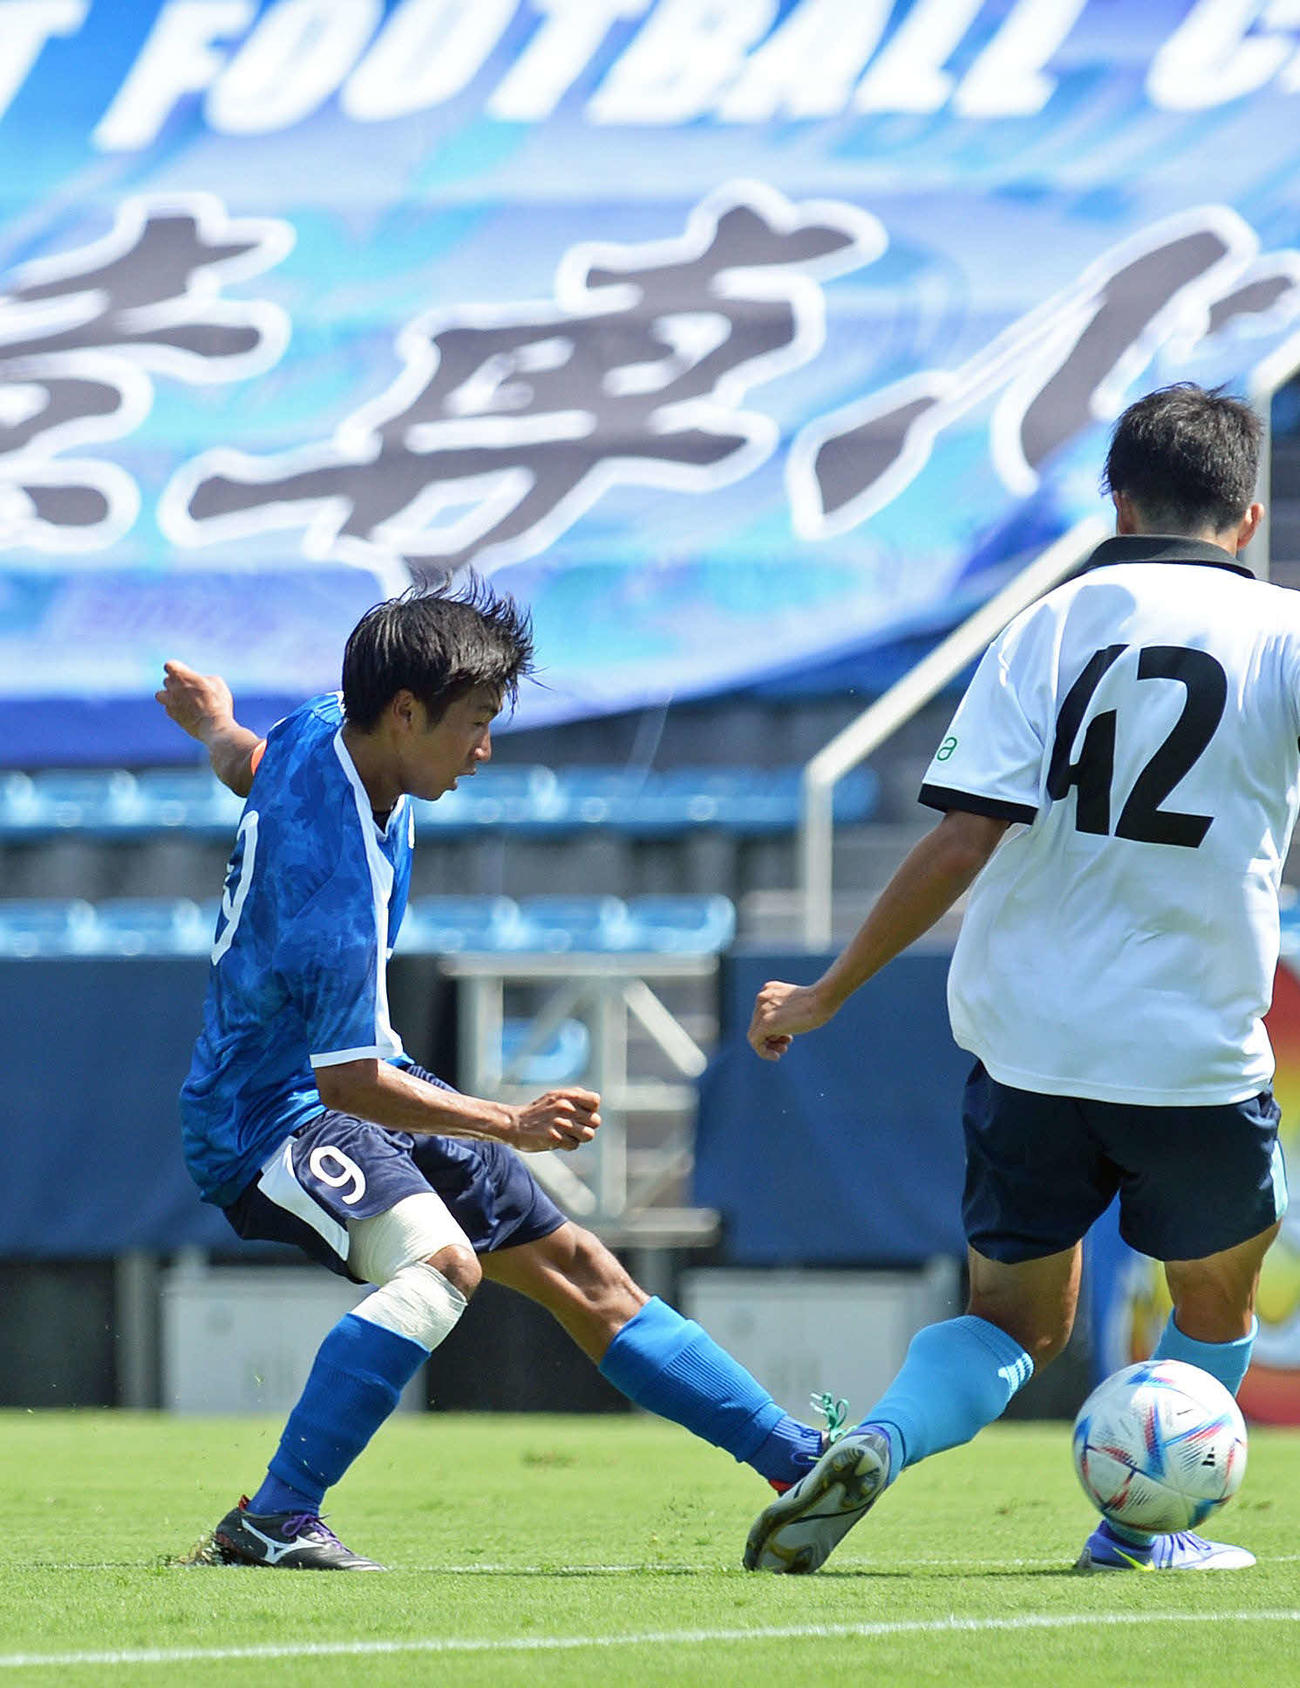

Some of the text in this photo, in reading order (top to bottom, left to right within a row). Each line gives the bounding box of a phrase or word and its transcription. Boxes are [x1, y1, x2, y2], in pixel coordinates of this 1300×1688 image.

[88, 0, 1058, 152] FOOTBALL
[1047, 644, 1228, 849] 42
[309, 1145, 366, 1205] 9
